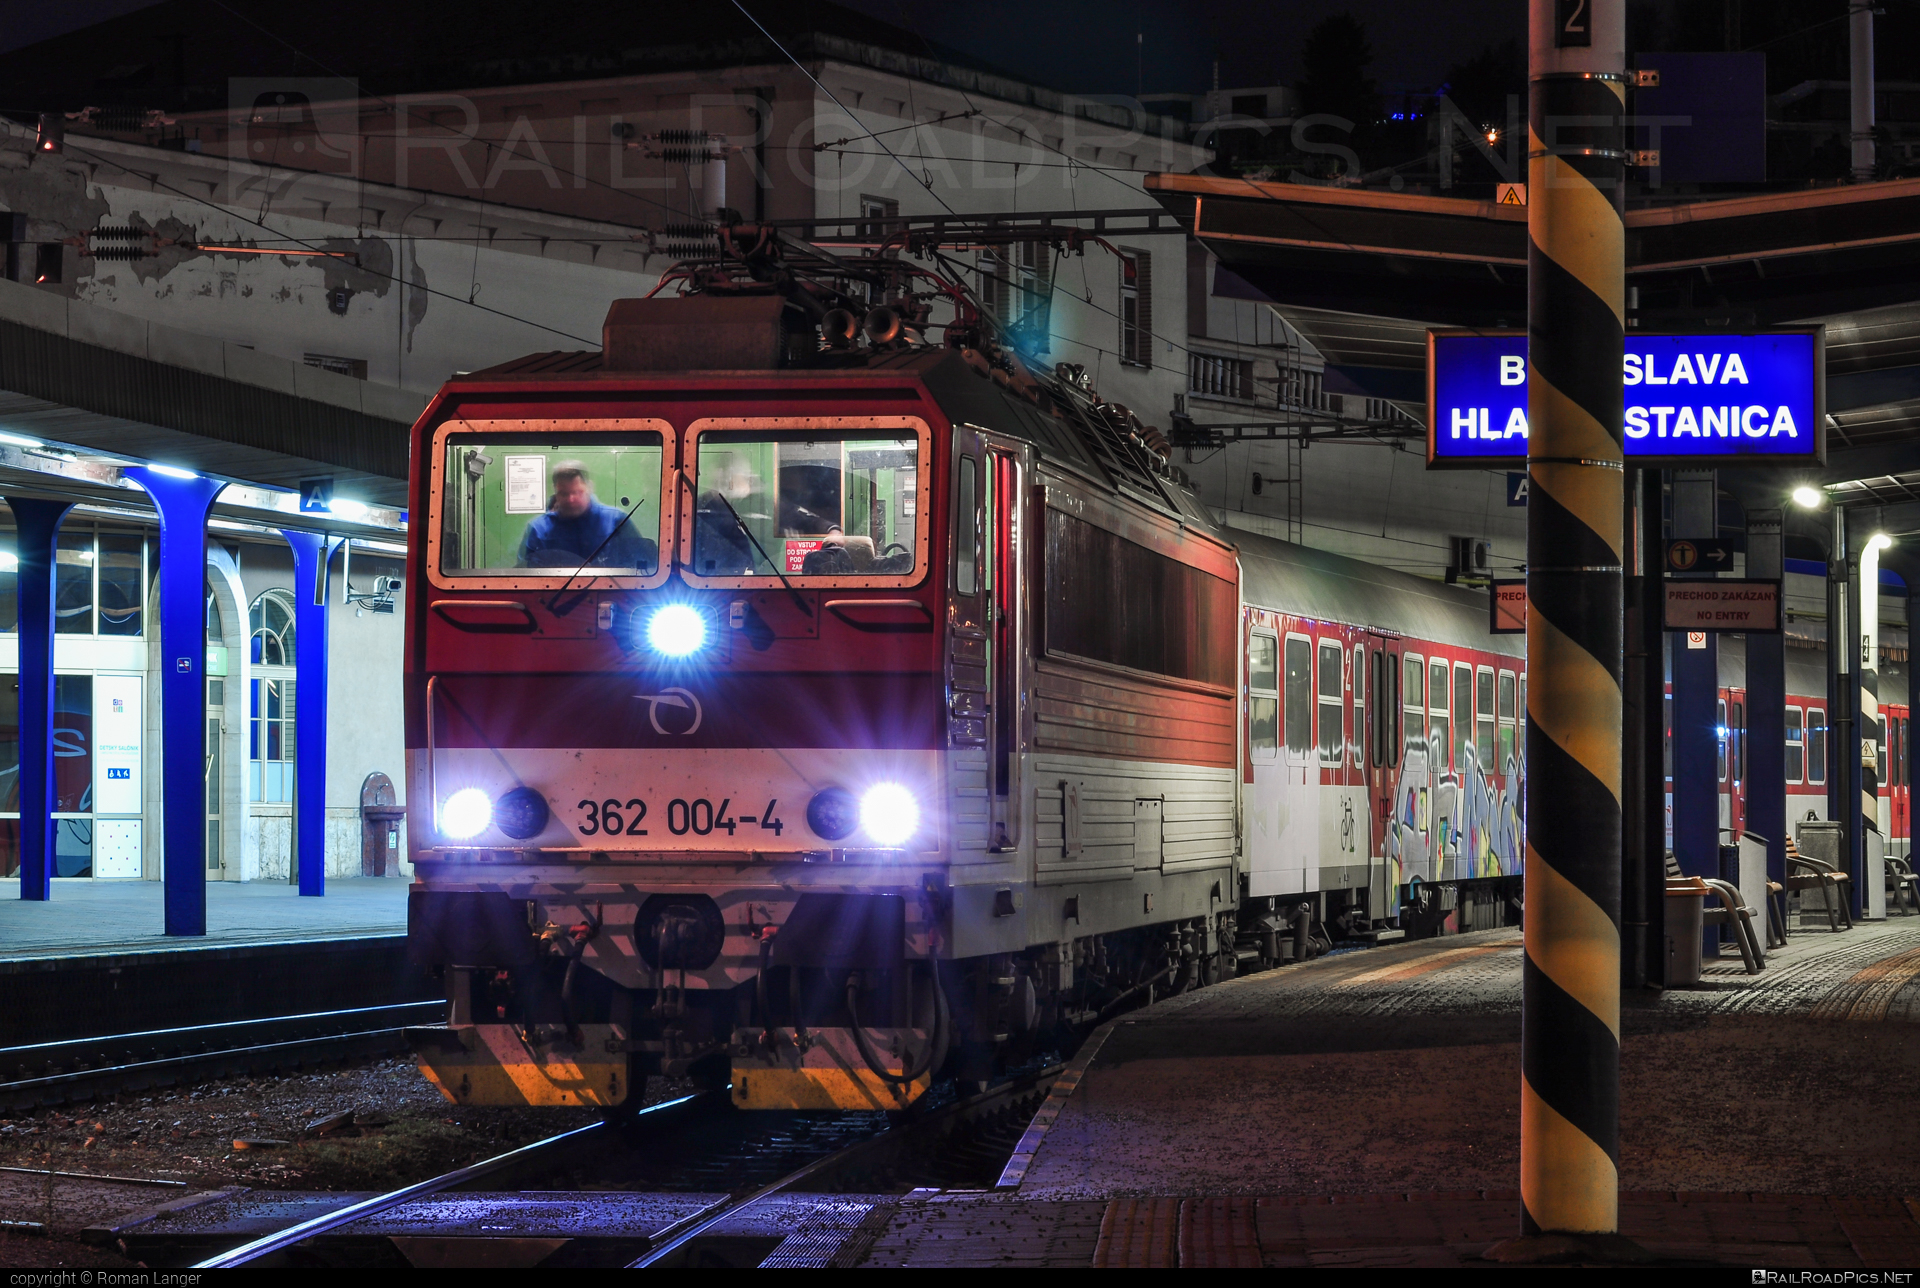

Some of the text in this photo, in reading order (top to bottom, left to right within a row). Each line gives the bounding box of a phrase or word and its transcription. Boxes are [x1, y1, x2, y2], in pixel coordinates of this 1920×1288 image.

[1500, 353, 1749, 386] BSLAVA
[1624, 405, 1798, 440] STANICA
[306, 486, 327, 508] A
[1669, 591, 1719, 600] PRECHOD
[1697, 611, 1750, 620] NO ENTRY
[577, 798, 784, 837] 362 004-4
